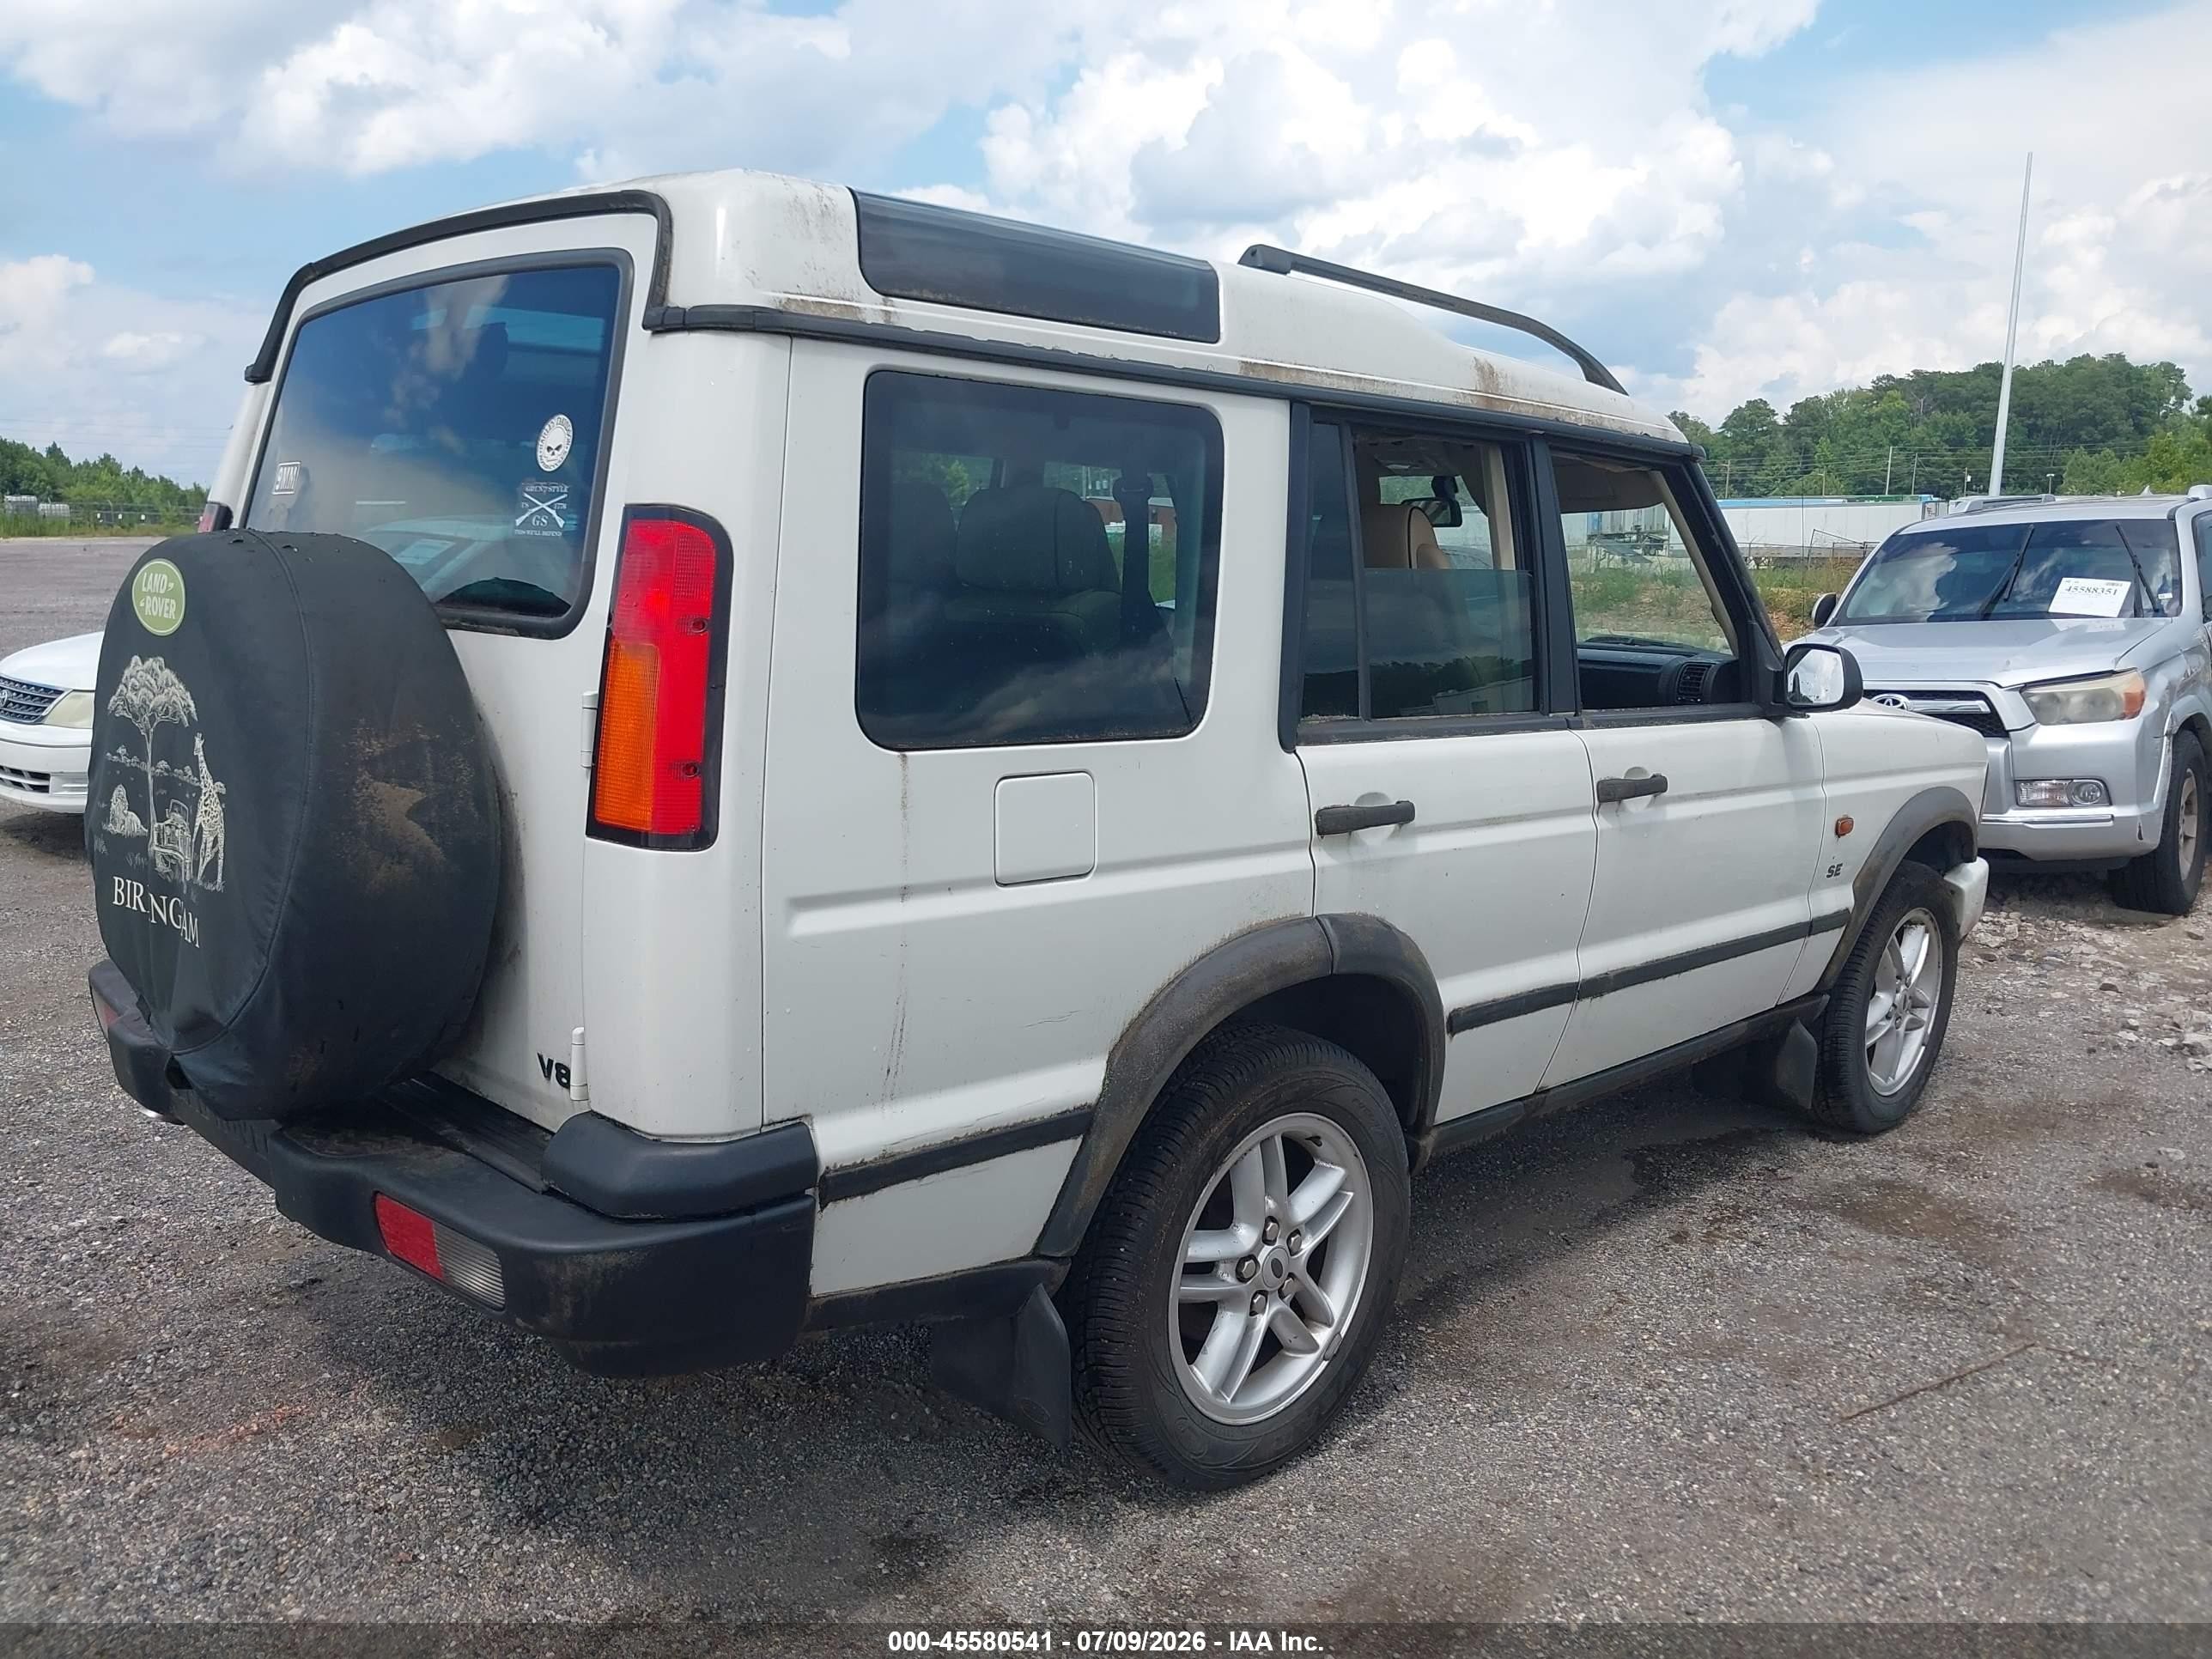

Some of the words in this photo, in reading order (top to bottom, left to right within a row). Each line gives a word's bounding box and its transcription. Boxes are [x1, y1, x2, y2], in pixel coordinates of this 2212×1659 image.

[532, 514, 549, 527] GS
[142, 571, 168, 594] LAND
[144, 595, 176, 620] ROVER
[1826, 862, 1844, 878] SE
[537, 1051, 571, 1091] V8
